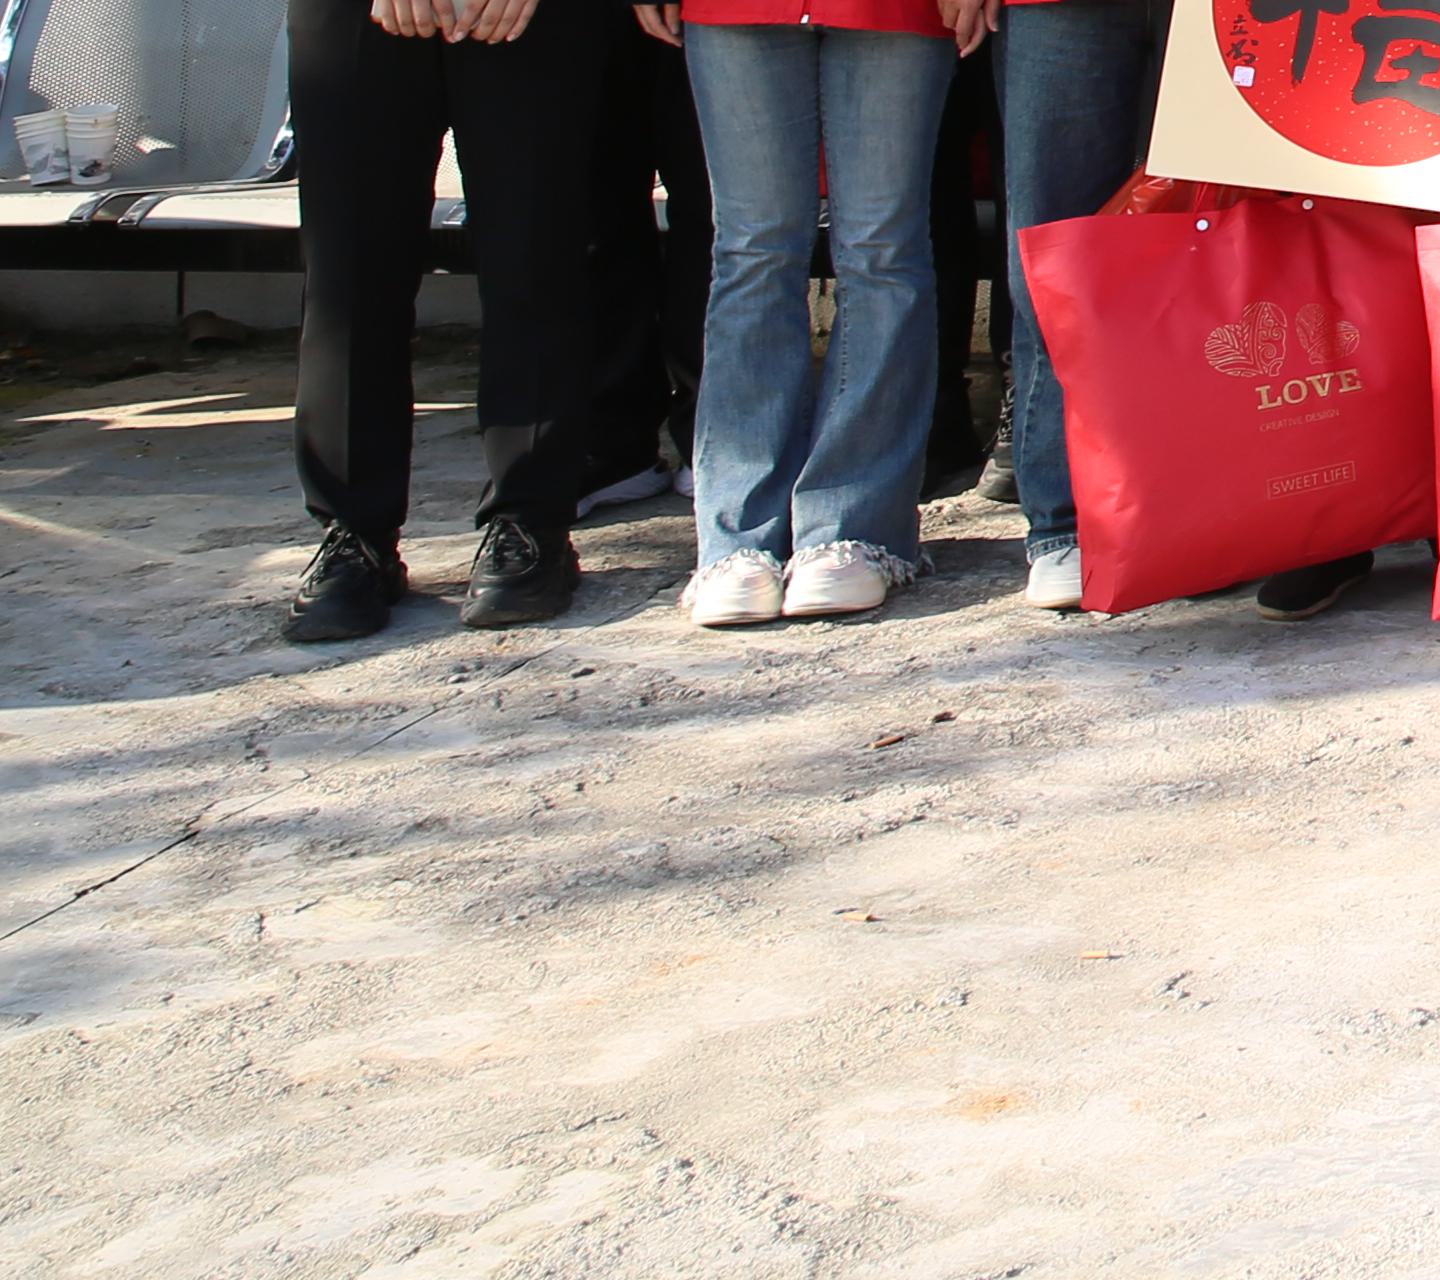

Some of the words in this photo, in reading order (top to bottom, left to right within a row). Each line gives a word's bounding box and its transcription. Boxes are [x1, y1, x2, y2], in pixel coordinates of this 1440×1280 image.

[1255, 368, 1363, 410] LOVE
[1272, 472, 1319, 495] SWEET
[1323, 465, 1350, 483] LIFE
